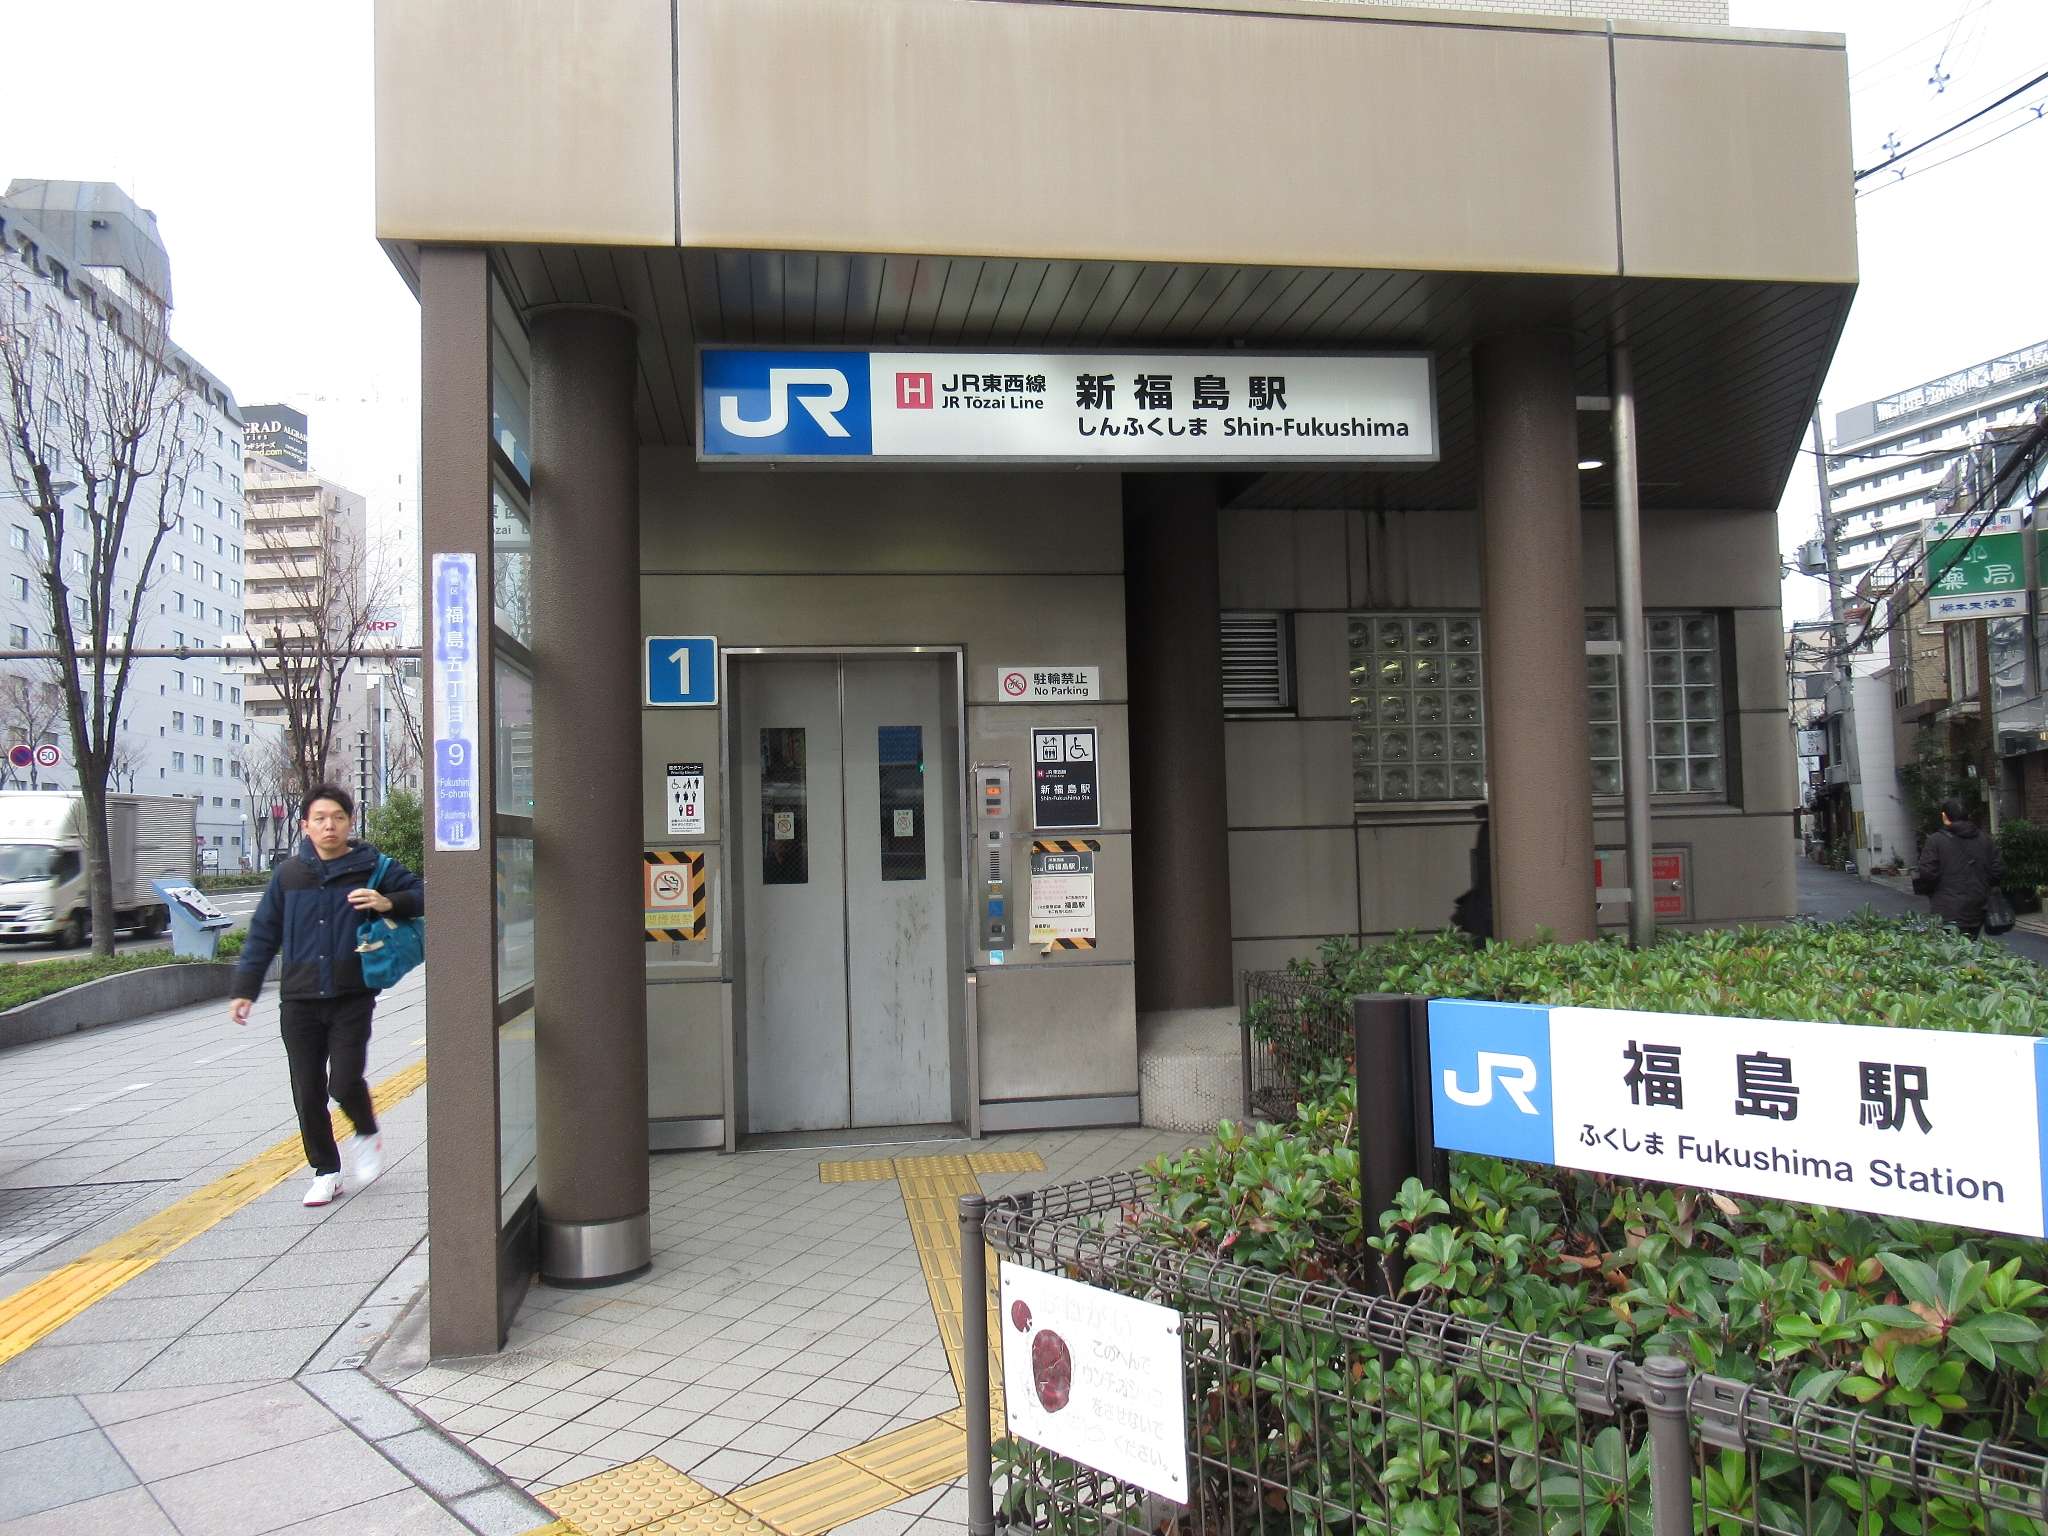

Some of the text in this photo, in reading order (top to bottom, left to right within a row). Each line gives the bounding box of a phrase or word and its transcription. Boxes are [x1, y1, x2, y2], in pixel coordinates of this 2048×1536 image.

[903, 377, 926, 405] H
[941, 373, 1047, 393] JR東西線
[1075, 373, 1288, 411] 新福島駅
[720, 368, 851, 438] JR
[941, 394, 1045, 410] JR Tōzai Line
[1077, 416, 1208, 437] しんふくしま
[1223, 416, 1410, 438] Shin-Fukushima
[667, 647, 690, 695] 1
[1033, 671, 1088, 685] 駐輪禁止
[1034, 686, 1089, 697] No Parking
[41, 751, 55, 761] 50
[447, 742, 465, 766] 9
[1040, 783, 1091, 795] 新福島駅
[1064, 901, 1086, 909] 福島駅
[1443, 1050, 1541, 1116] JR
[1622, 1039, 1934, 1136] 福島駅
[1579, 1123, 1665, 1156] ふくしま
[1678, 1134, 2005, 1203] Fukushima Station
